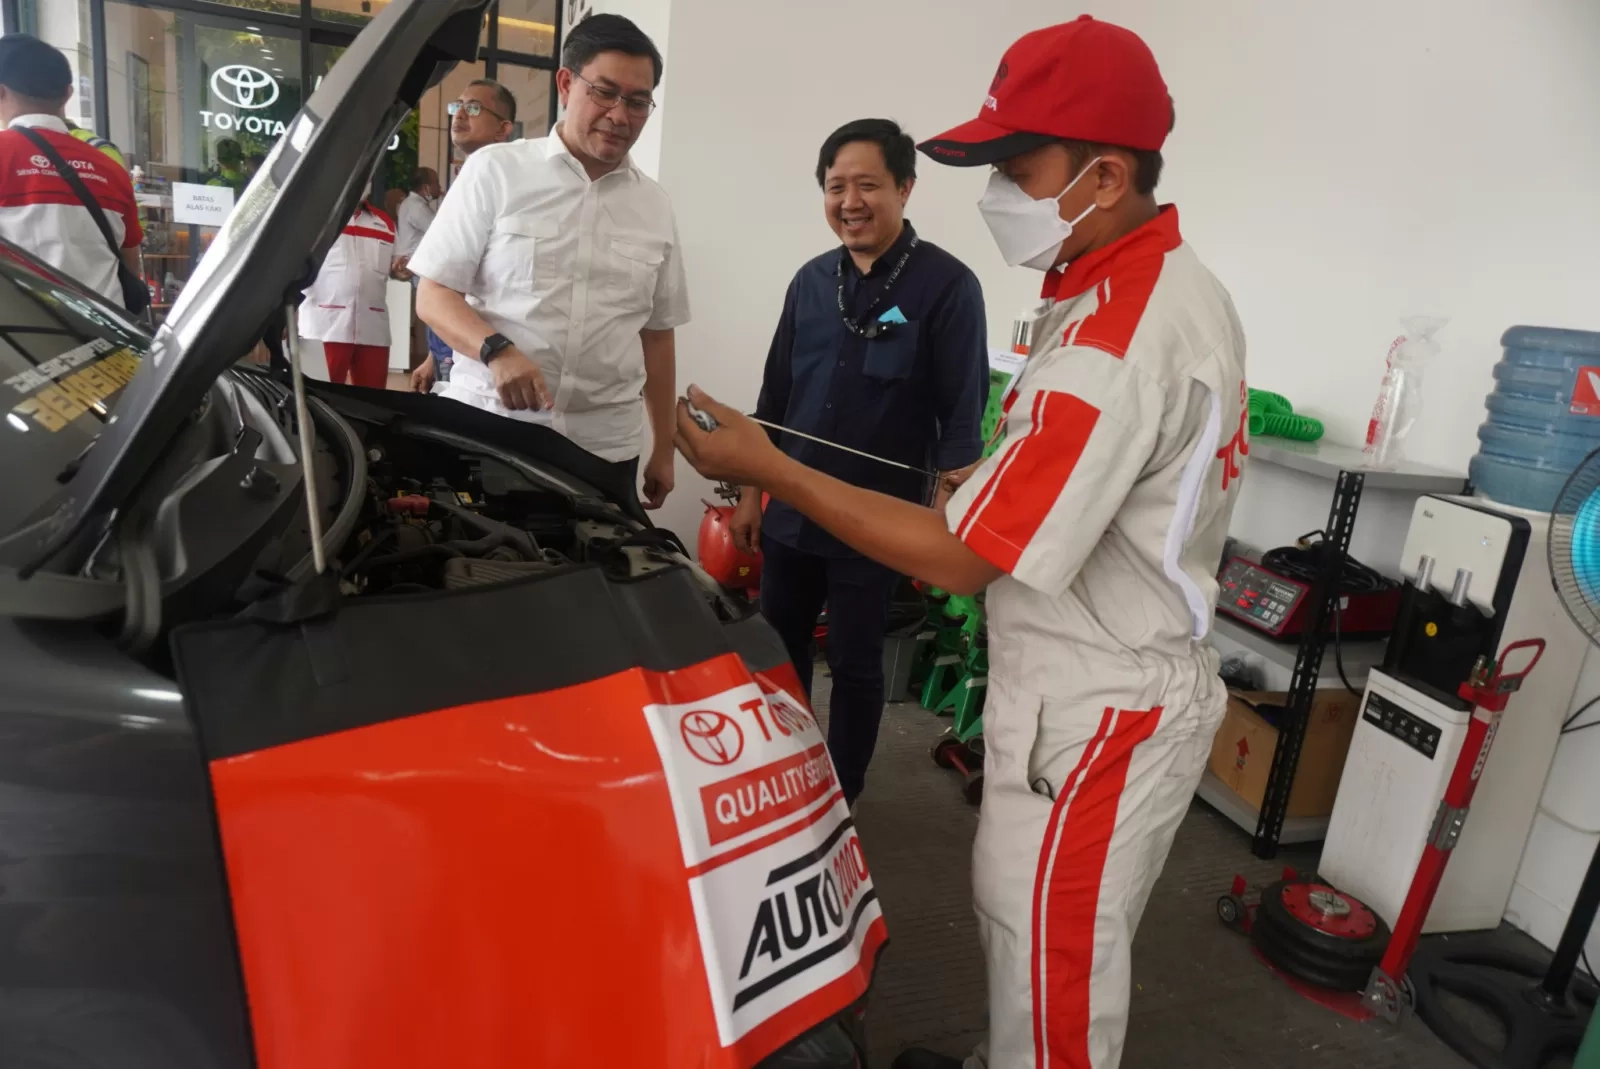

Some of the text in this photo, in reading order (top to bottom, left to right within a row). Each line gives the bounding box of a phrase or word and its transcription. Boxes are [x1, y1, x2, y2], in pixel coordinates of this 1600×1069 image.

[199, 110, 287, 137] TOYOTA
[186, 203, 204, 211] ALAS
[192, 194, 215, 203] BATAS
[714, 765, 806, 826] QUALITY
